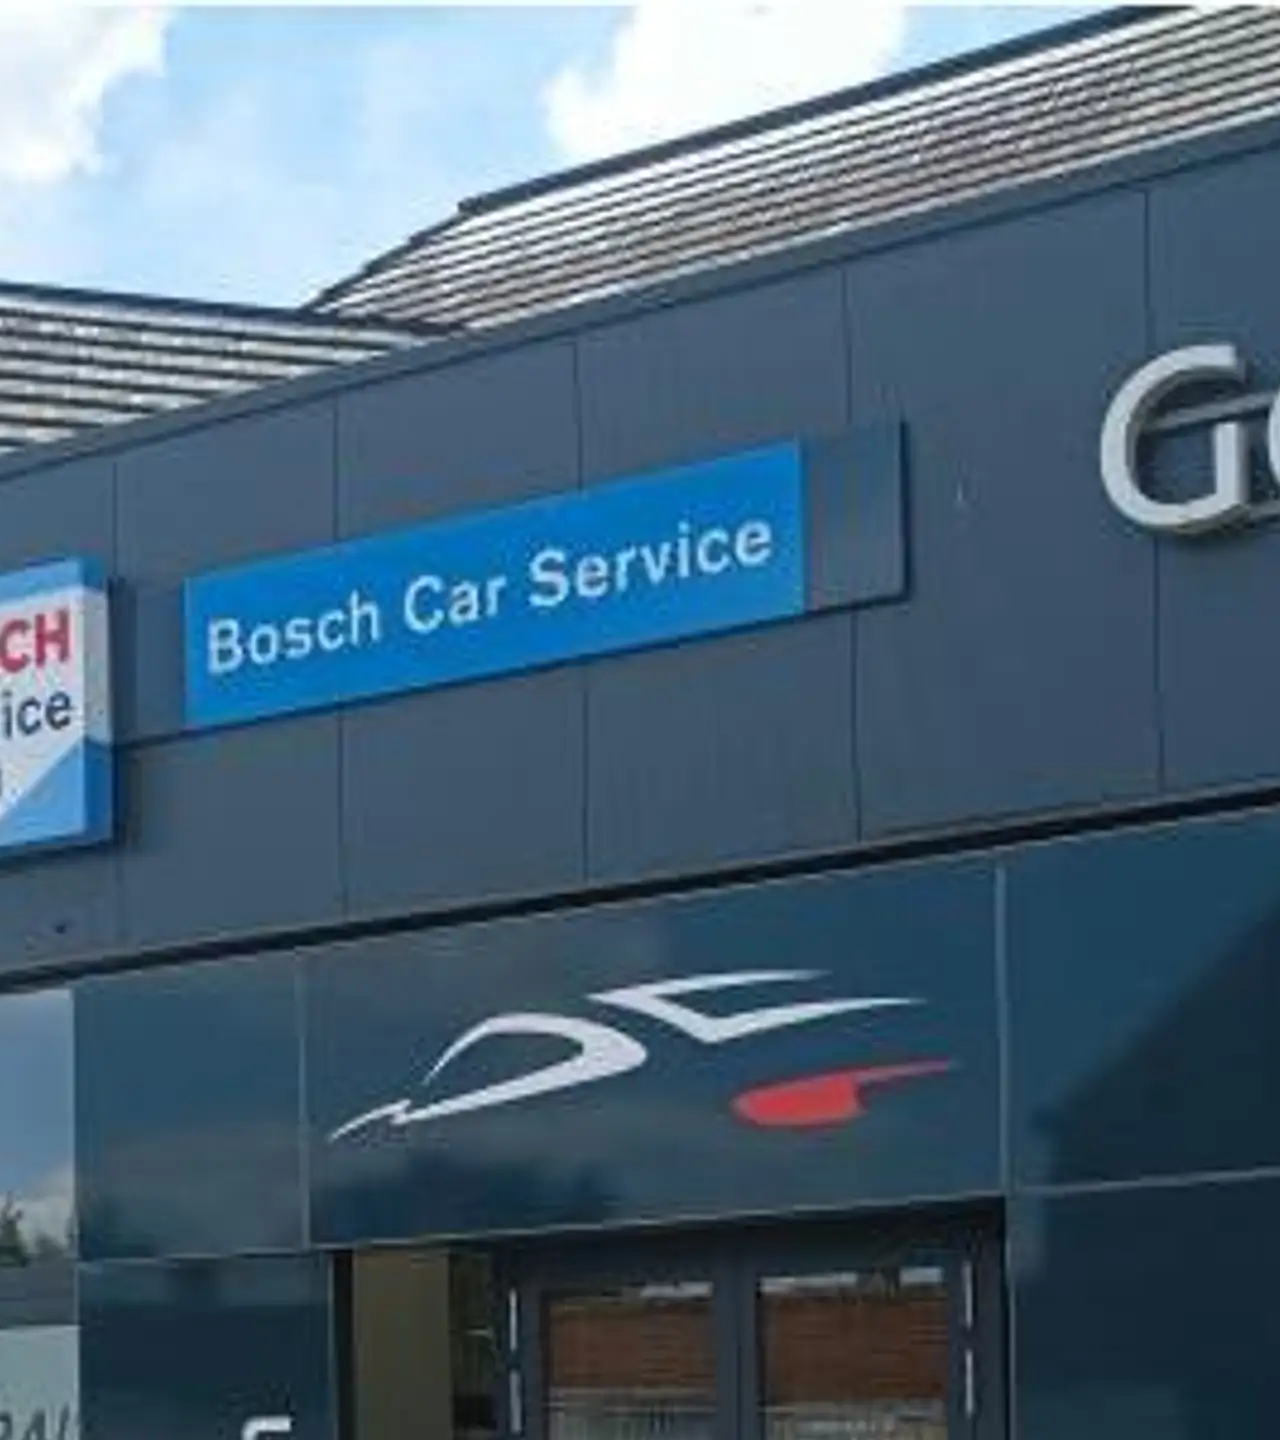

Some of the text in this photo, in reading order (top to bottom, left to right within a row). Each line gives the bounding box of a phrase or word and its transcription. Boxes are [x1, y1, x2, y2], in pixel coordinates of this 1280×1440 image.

[206, 520, 773, 674] Bosch Car Service
